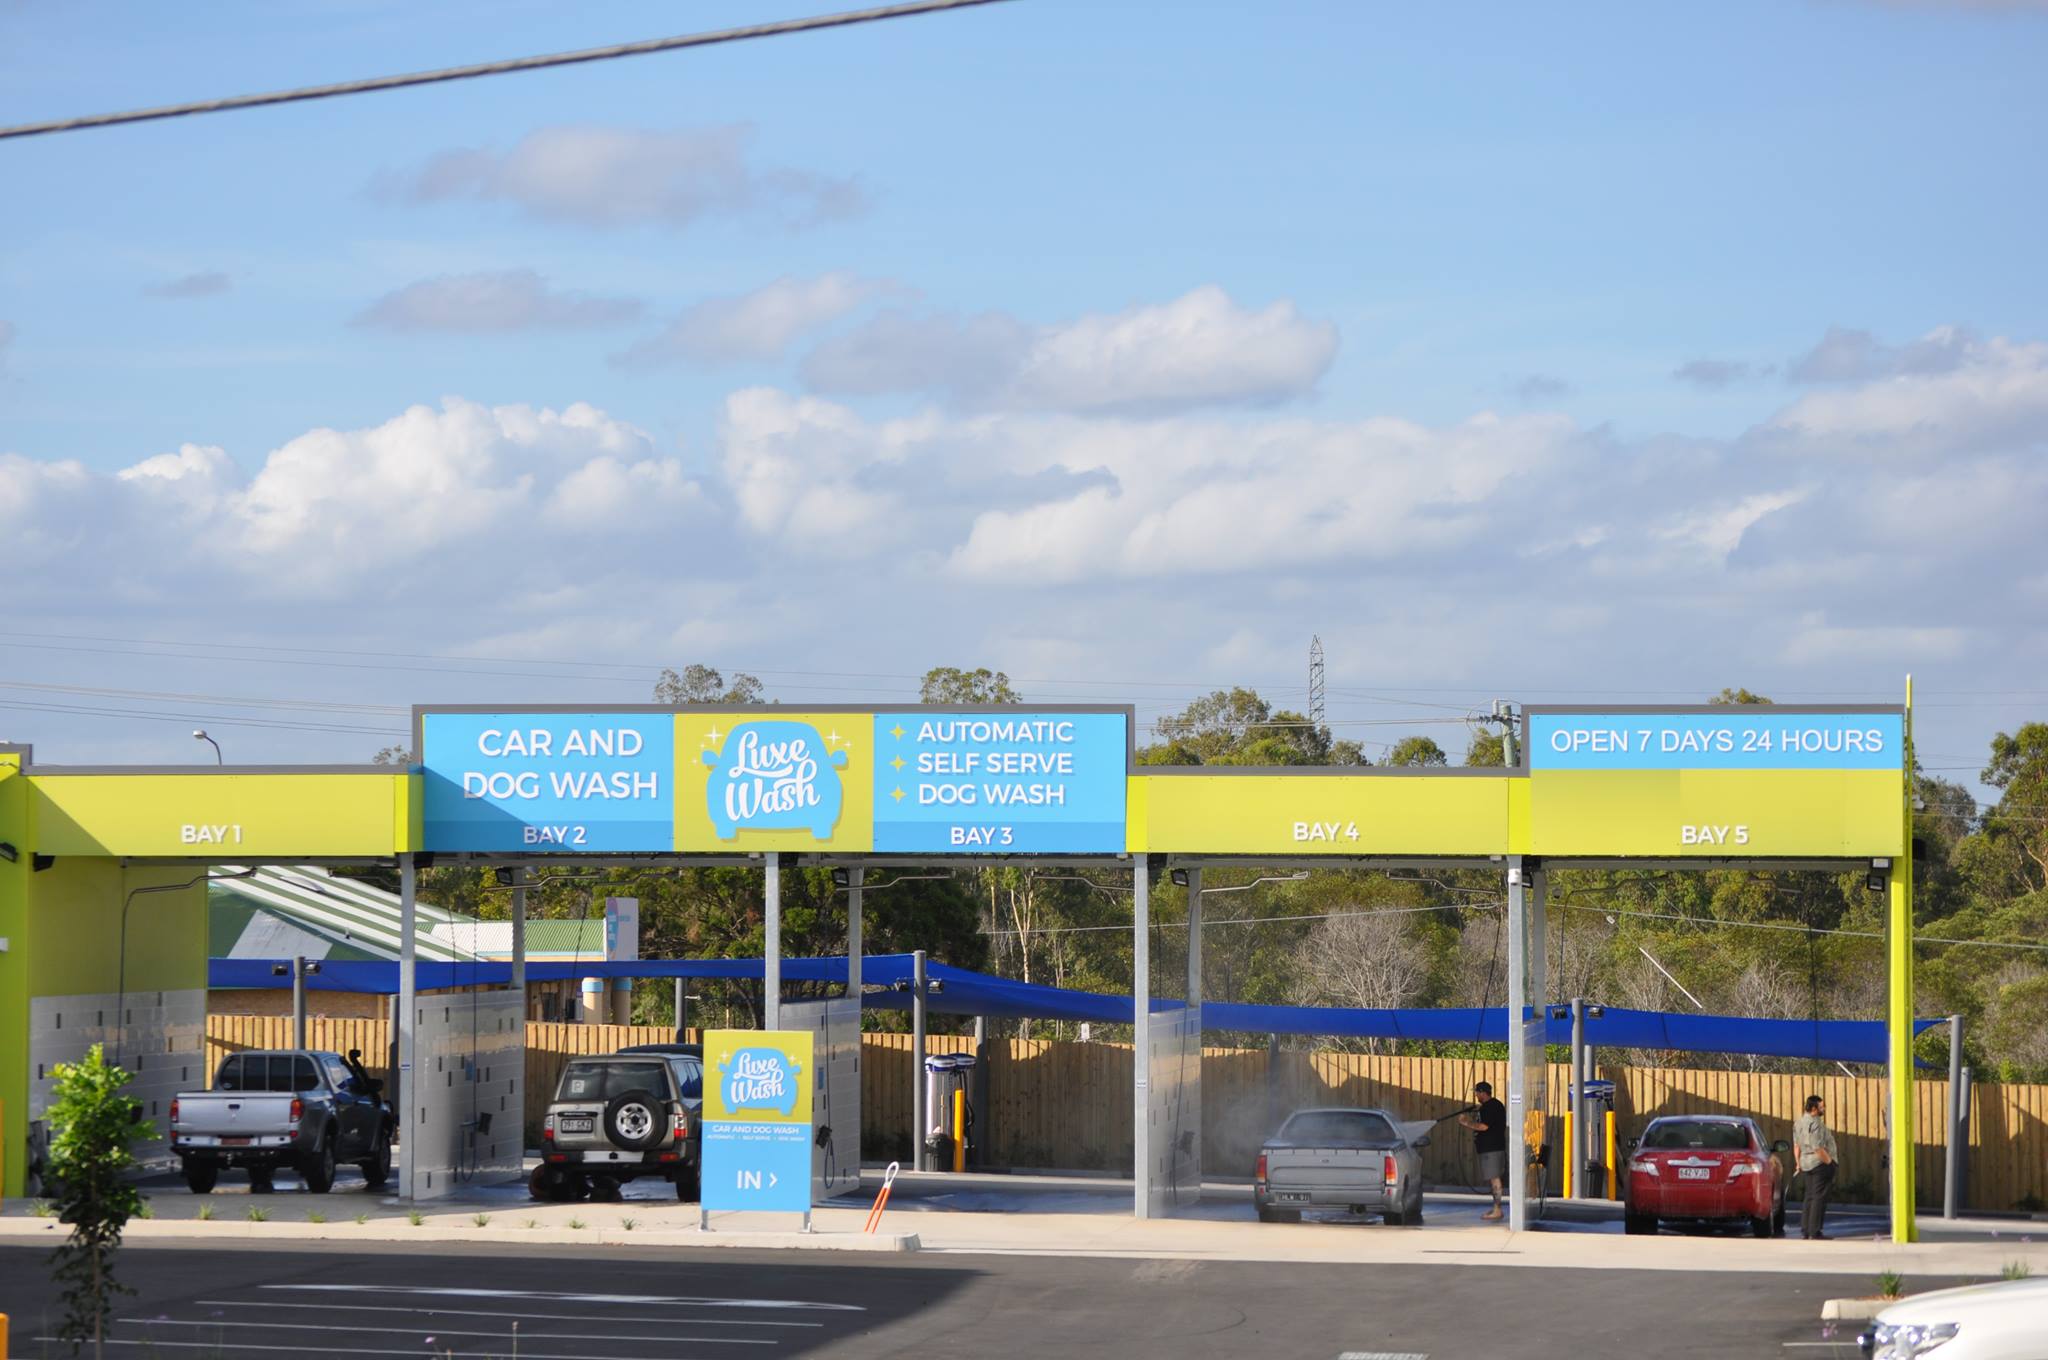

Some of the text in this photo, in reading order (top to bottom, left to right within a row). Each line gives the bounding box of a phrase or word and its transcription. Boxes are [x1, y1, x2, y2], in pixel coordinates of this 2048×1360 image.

[477, 729, 644, 757] CAR AND
[917, 721, 1074, 743] AUTOMATIC
[1550, 729, 1884, 753] OPEN 7 DAYS 24 HOURS
[728, 730, 810, 778] Luxe
[917, 752, 1074, 774] SELF SERVE
[463, 771, 658, 799] DOG WASH
[724, 758, 821, 821] Wash
[918, 783, 1065, 805] DOG WASH
[180, 824, 241, 844] BAY 1
[523, 826, 587, 845] BAY 2
[950, 826, 1013, 846] BAY 3
[1293, 821, 1360, 841] BAY 4
[1681, 825, 1749, 845] BAY 5
[732, 1052, 780, 1080] Luxe
[730, 1068, 786, 1104] Wash
[712, 1124, 800, 1136] CAR AND DOG WASH
[736, 1170, 762, 1190] IN
